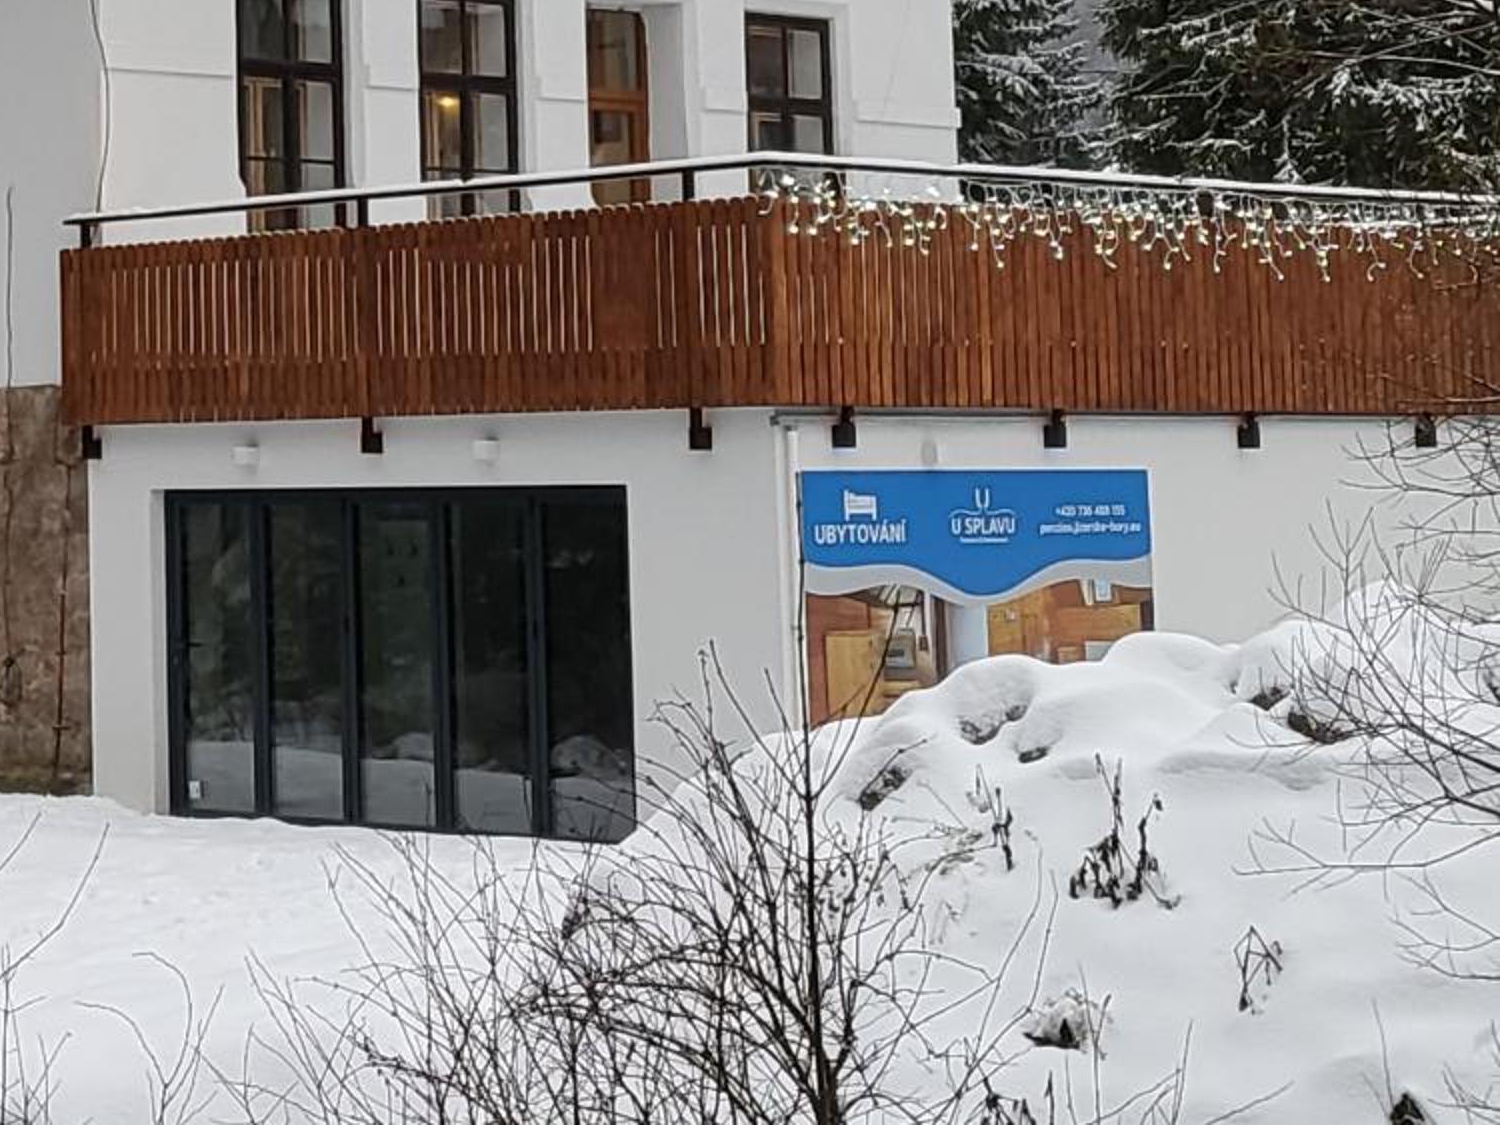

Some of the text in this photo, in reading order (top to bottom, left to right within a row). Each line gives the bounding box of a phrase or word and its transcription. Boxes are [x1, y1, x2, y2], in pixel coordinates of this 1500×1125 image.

[814, 518, 907, 545] UBYTOVÁNÍ
[951, 516, 1016, 535] U SPLAVU
